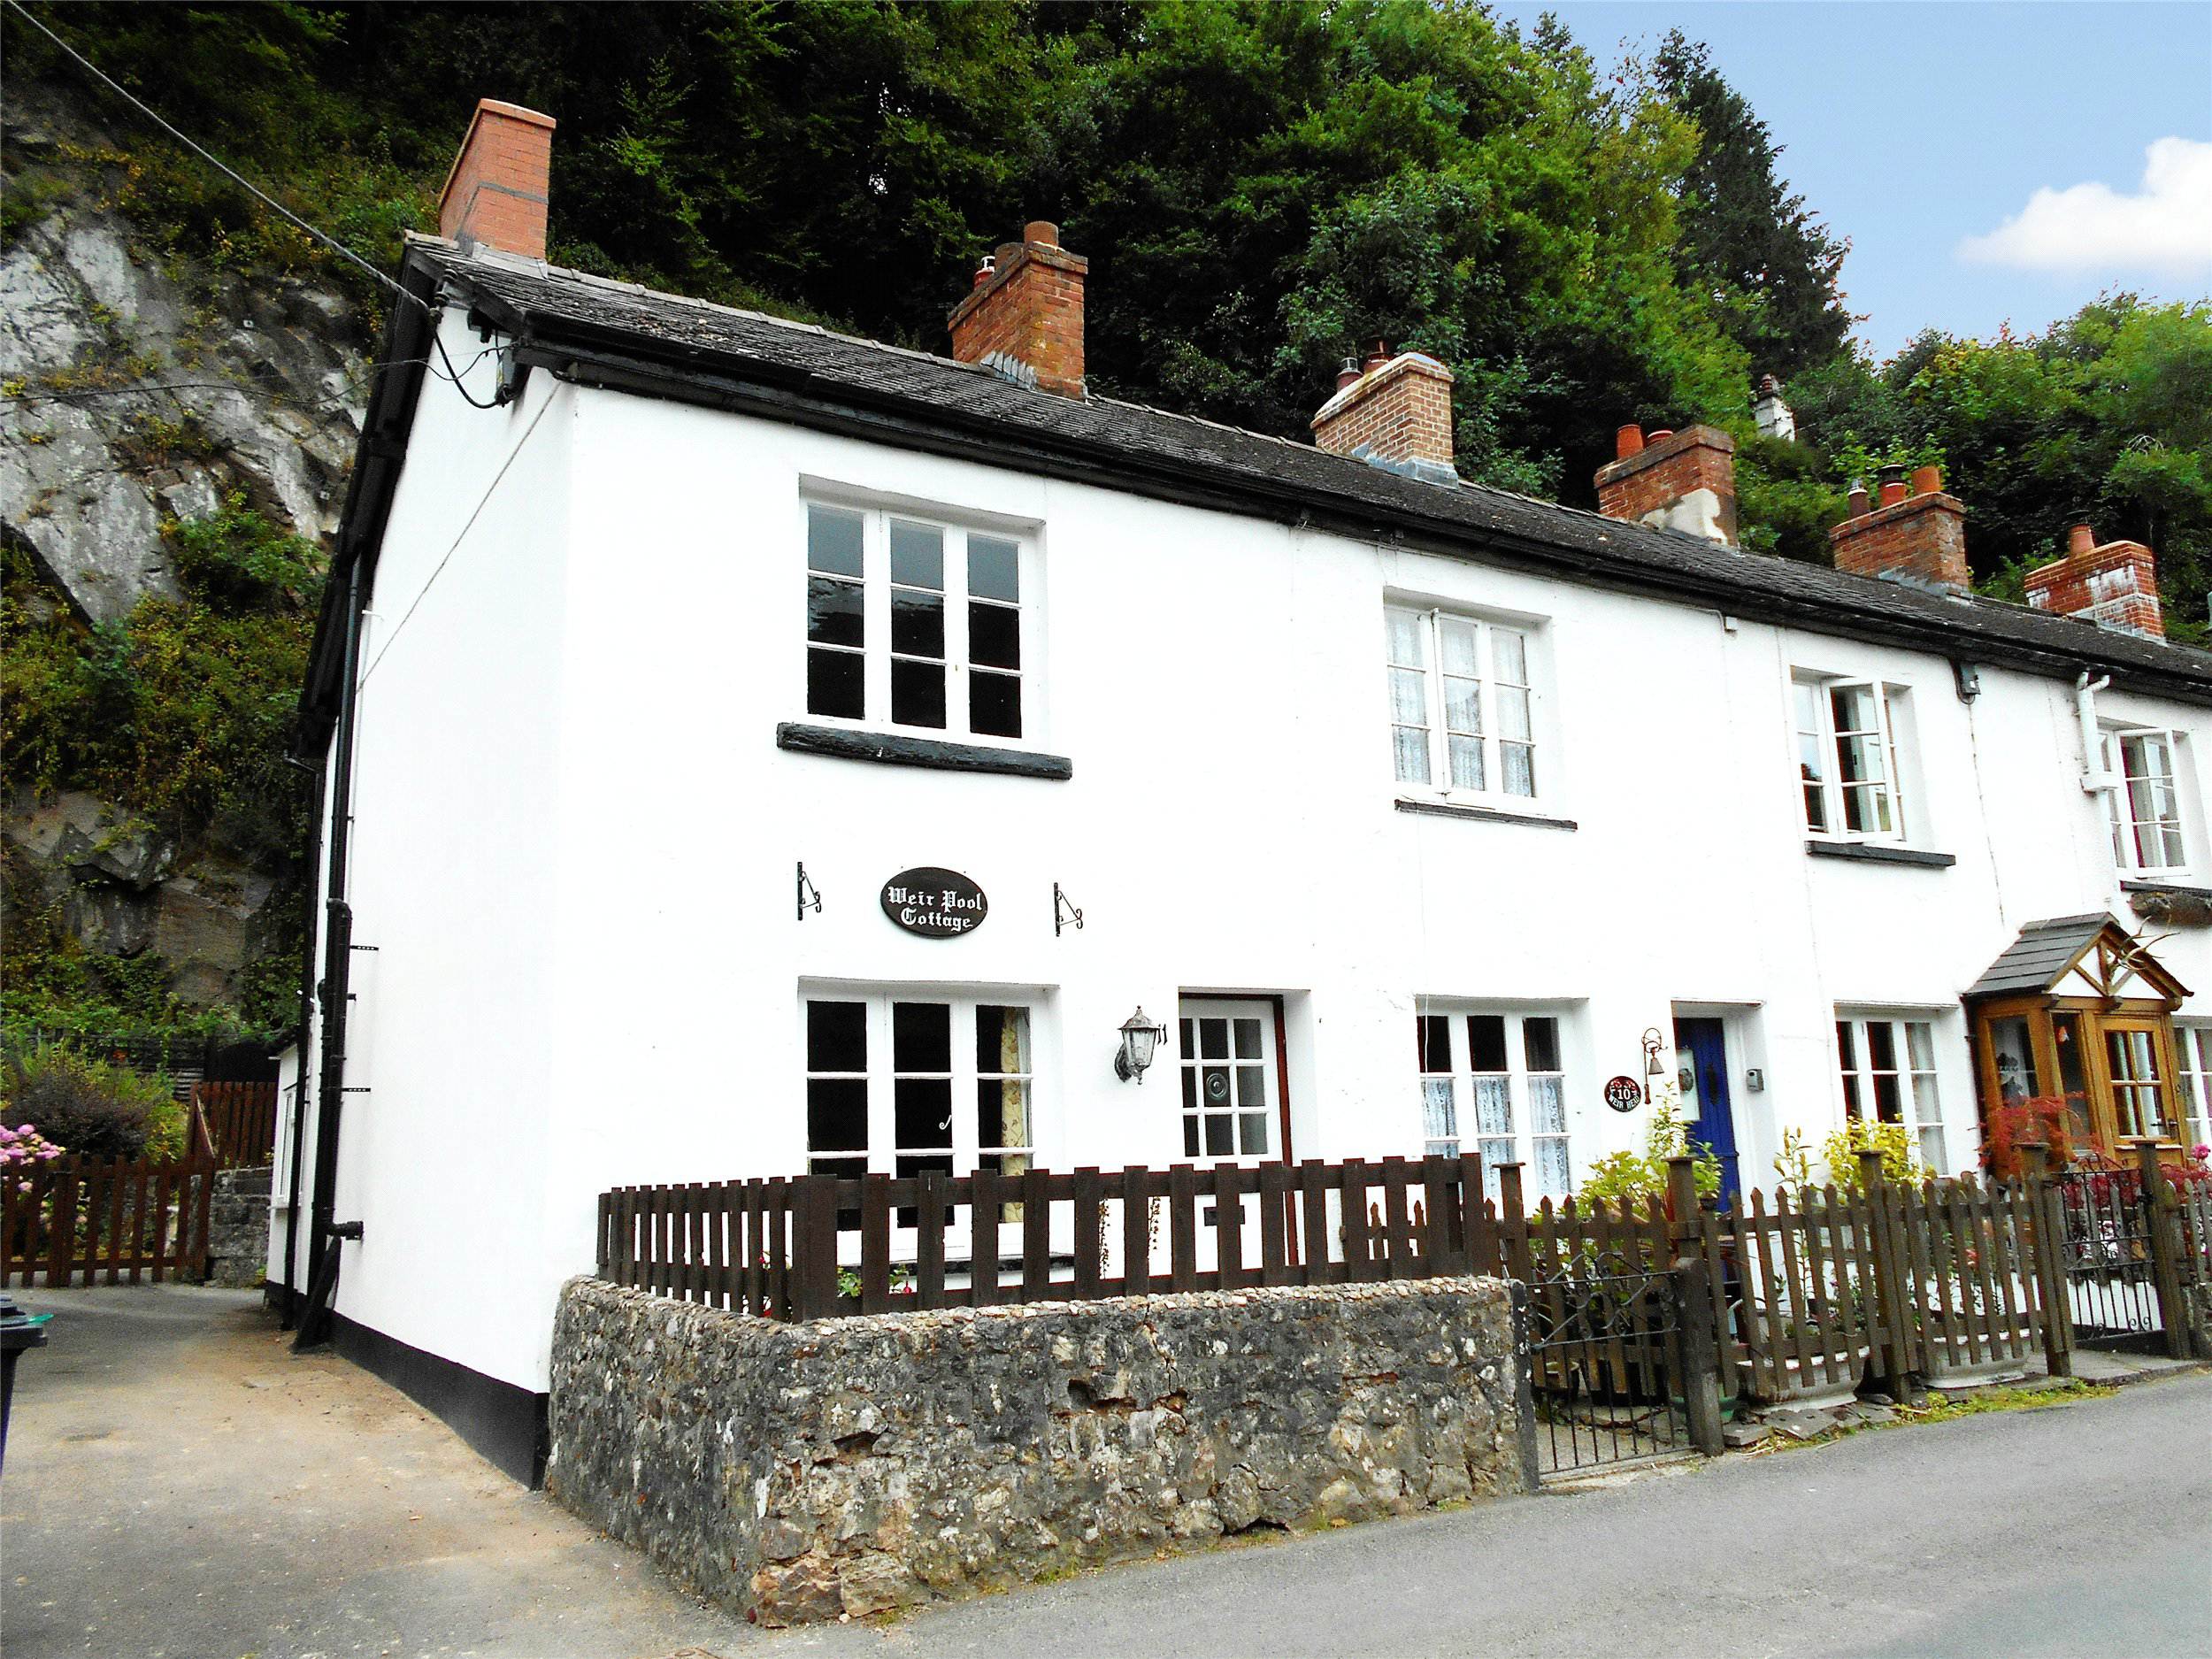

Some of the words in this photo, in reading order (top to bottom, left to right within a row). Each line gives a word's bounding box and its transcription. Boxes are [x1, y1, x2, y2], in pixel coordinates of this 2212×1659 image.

[887, 887, 935, 906] Weir
[941, 890, 982, 913] Pool
[900, 907, 973, 932] Cottage
[1609, 1094, 1624, 1109] WEIR
[1617, 1088, 1631, 1100] 10
